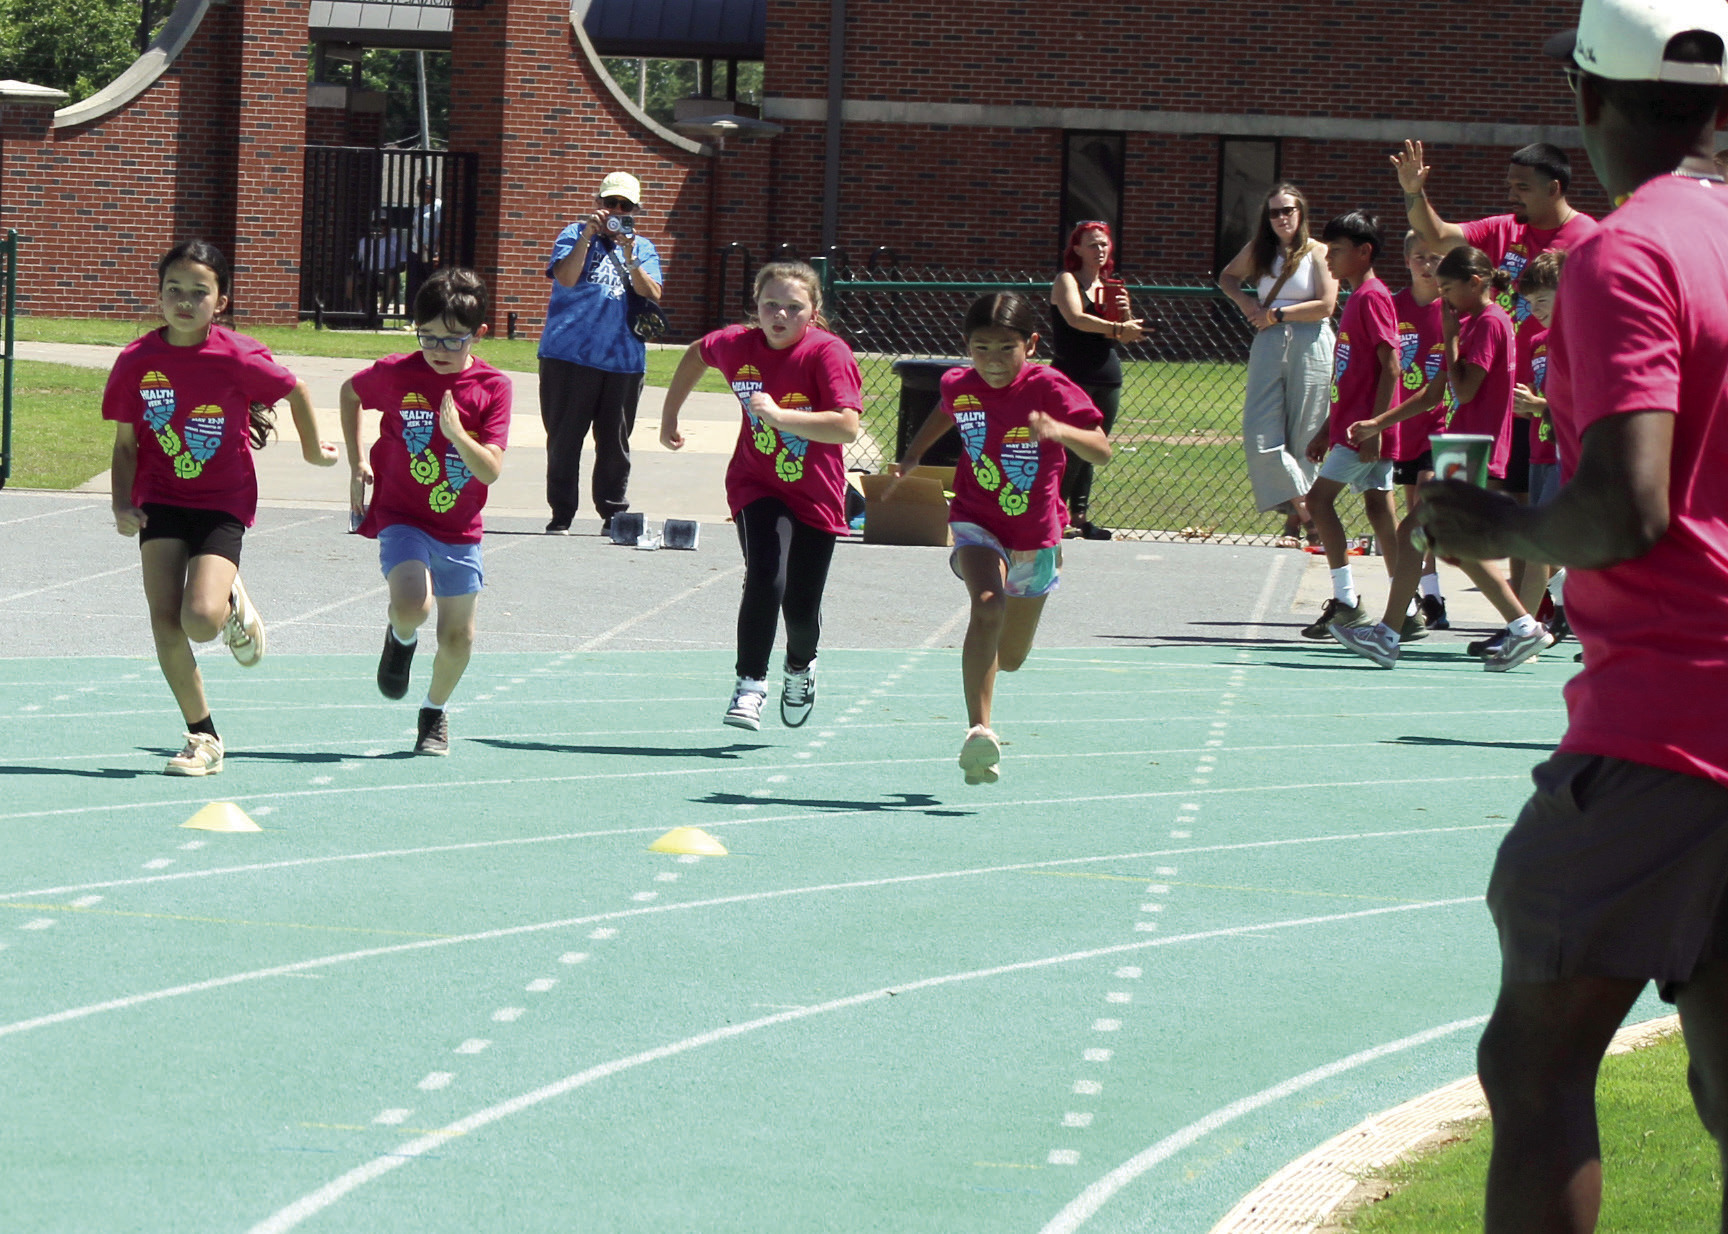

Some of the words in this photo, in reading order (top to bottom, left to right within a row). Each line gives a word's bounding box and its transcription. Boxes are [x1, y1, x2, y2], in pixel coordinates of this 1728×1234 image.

[732, 381, 763, 392] HEALTH
[139, 389, 174, 400] HEALTH
[399, 410, 434, 420] HEALTH
[953, 411, 985, 423] HEALTH
